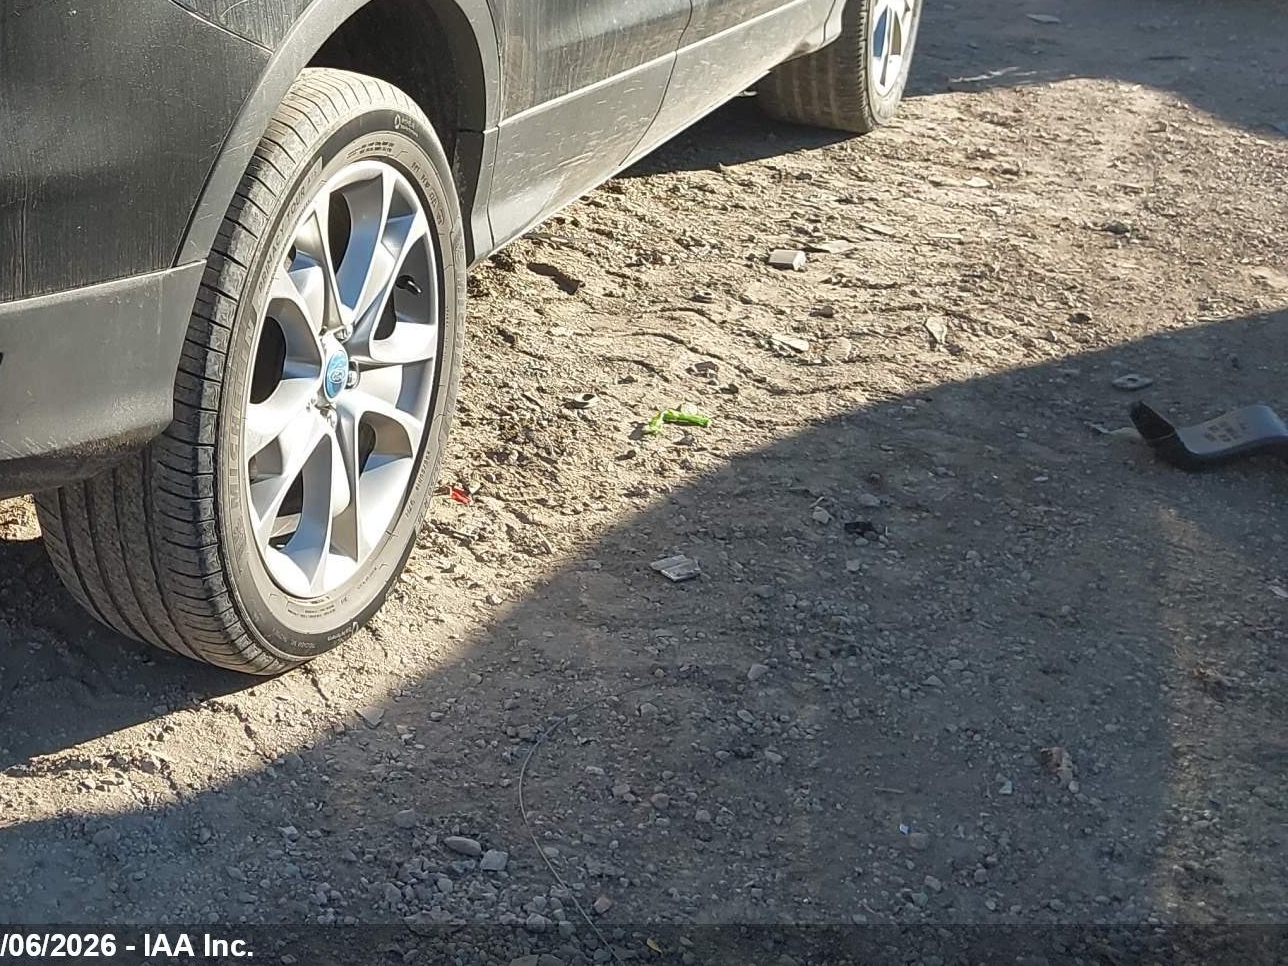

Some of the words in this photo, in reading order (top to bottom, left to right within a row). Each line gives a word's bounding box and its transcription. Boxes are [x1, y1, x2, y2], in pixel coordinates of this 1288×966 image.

[258, 227, 285, 294] PRIMACY
[286, 186, 306, 219] TOUR
[228, 319, 255, 511] MICHELIN
